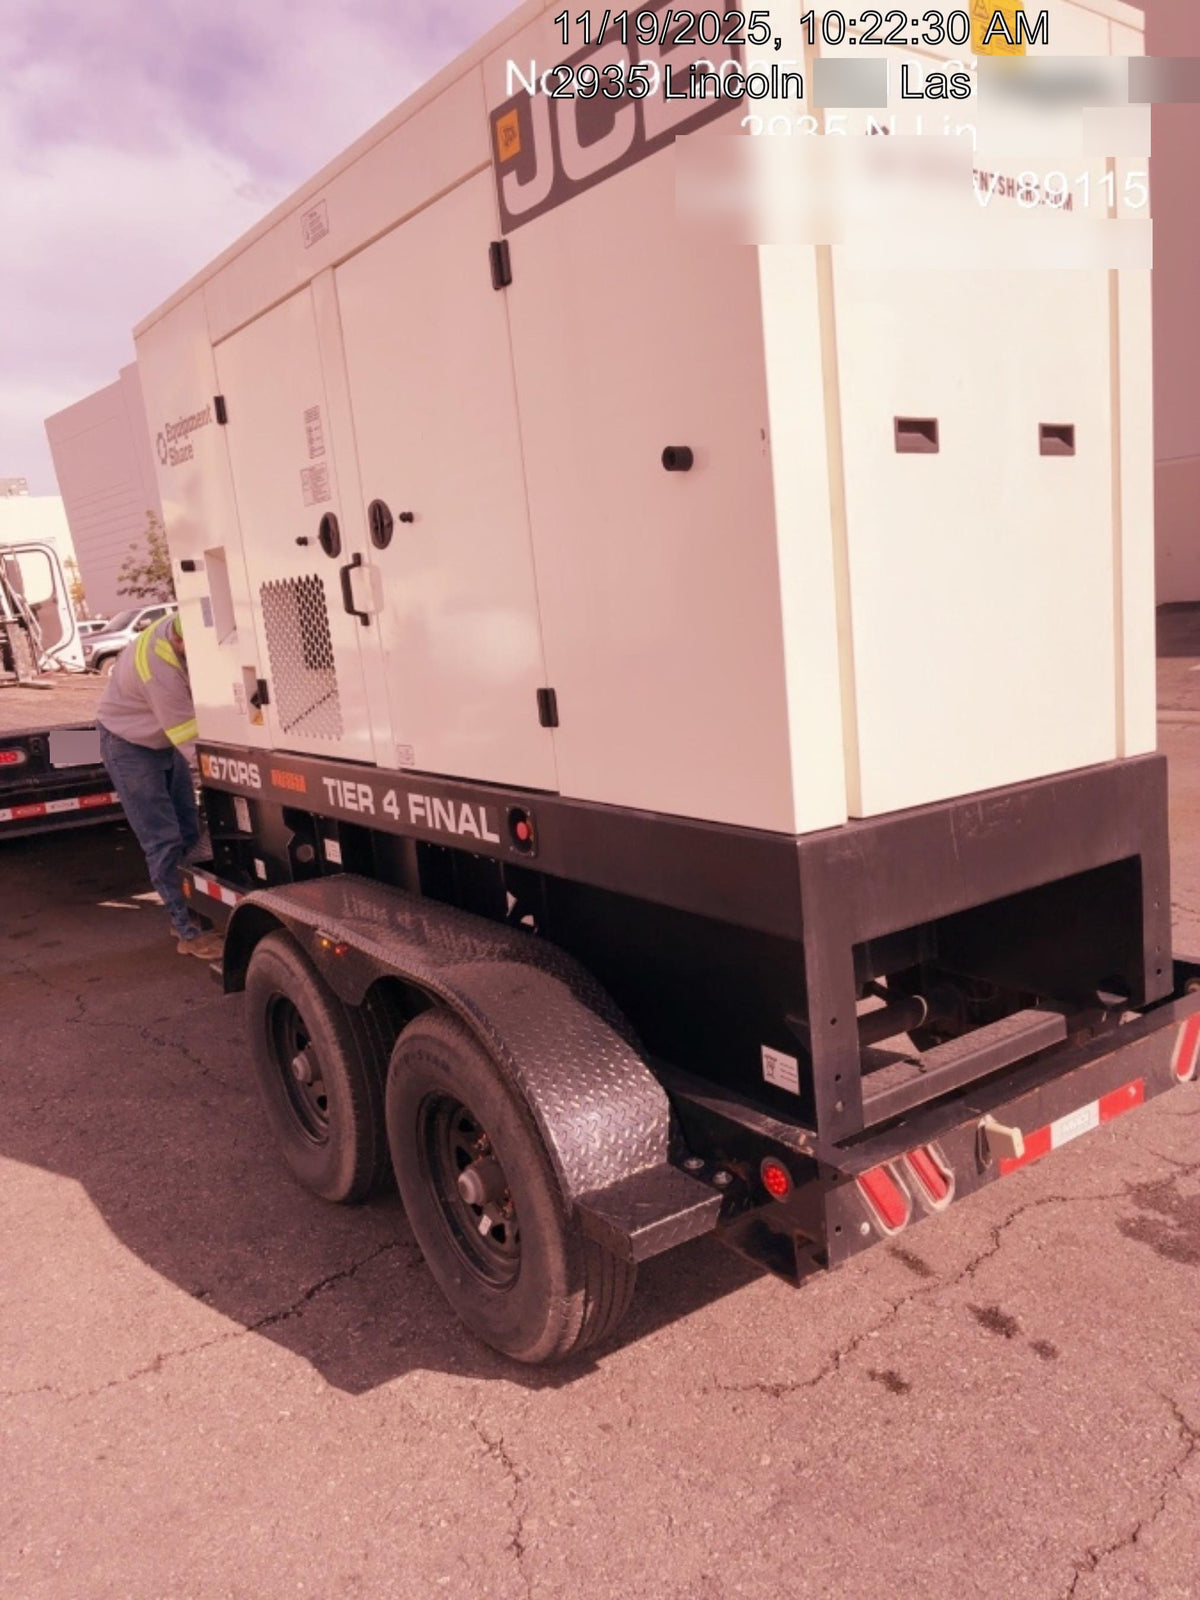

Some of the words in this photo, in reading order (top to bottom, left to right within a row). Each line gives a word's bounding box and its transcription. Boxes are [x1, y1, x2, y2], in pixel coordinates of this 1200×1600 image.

[322, 777, 375, 815] TIER
[382, 790, 400, 820] 4
[407, 793, 500, 844] FINAL
